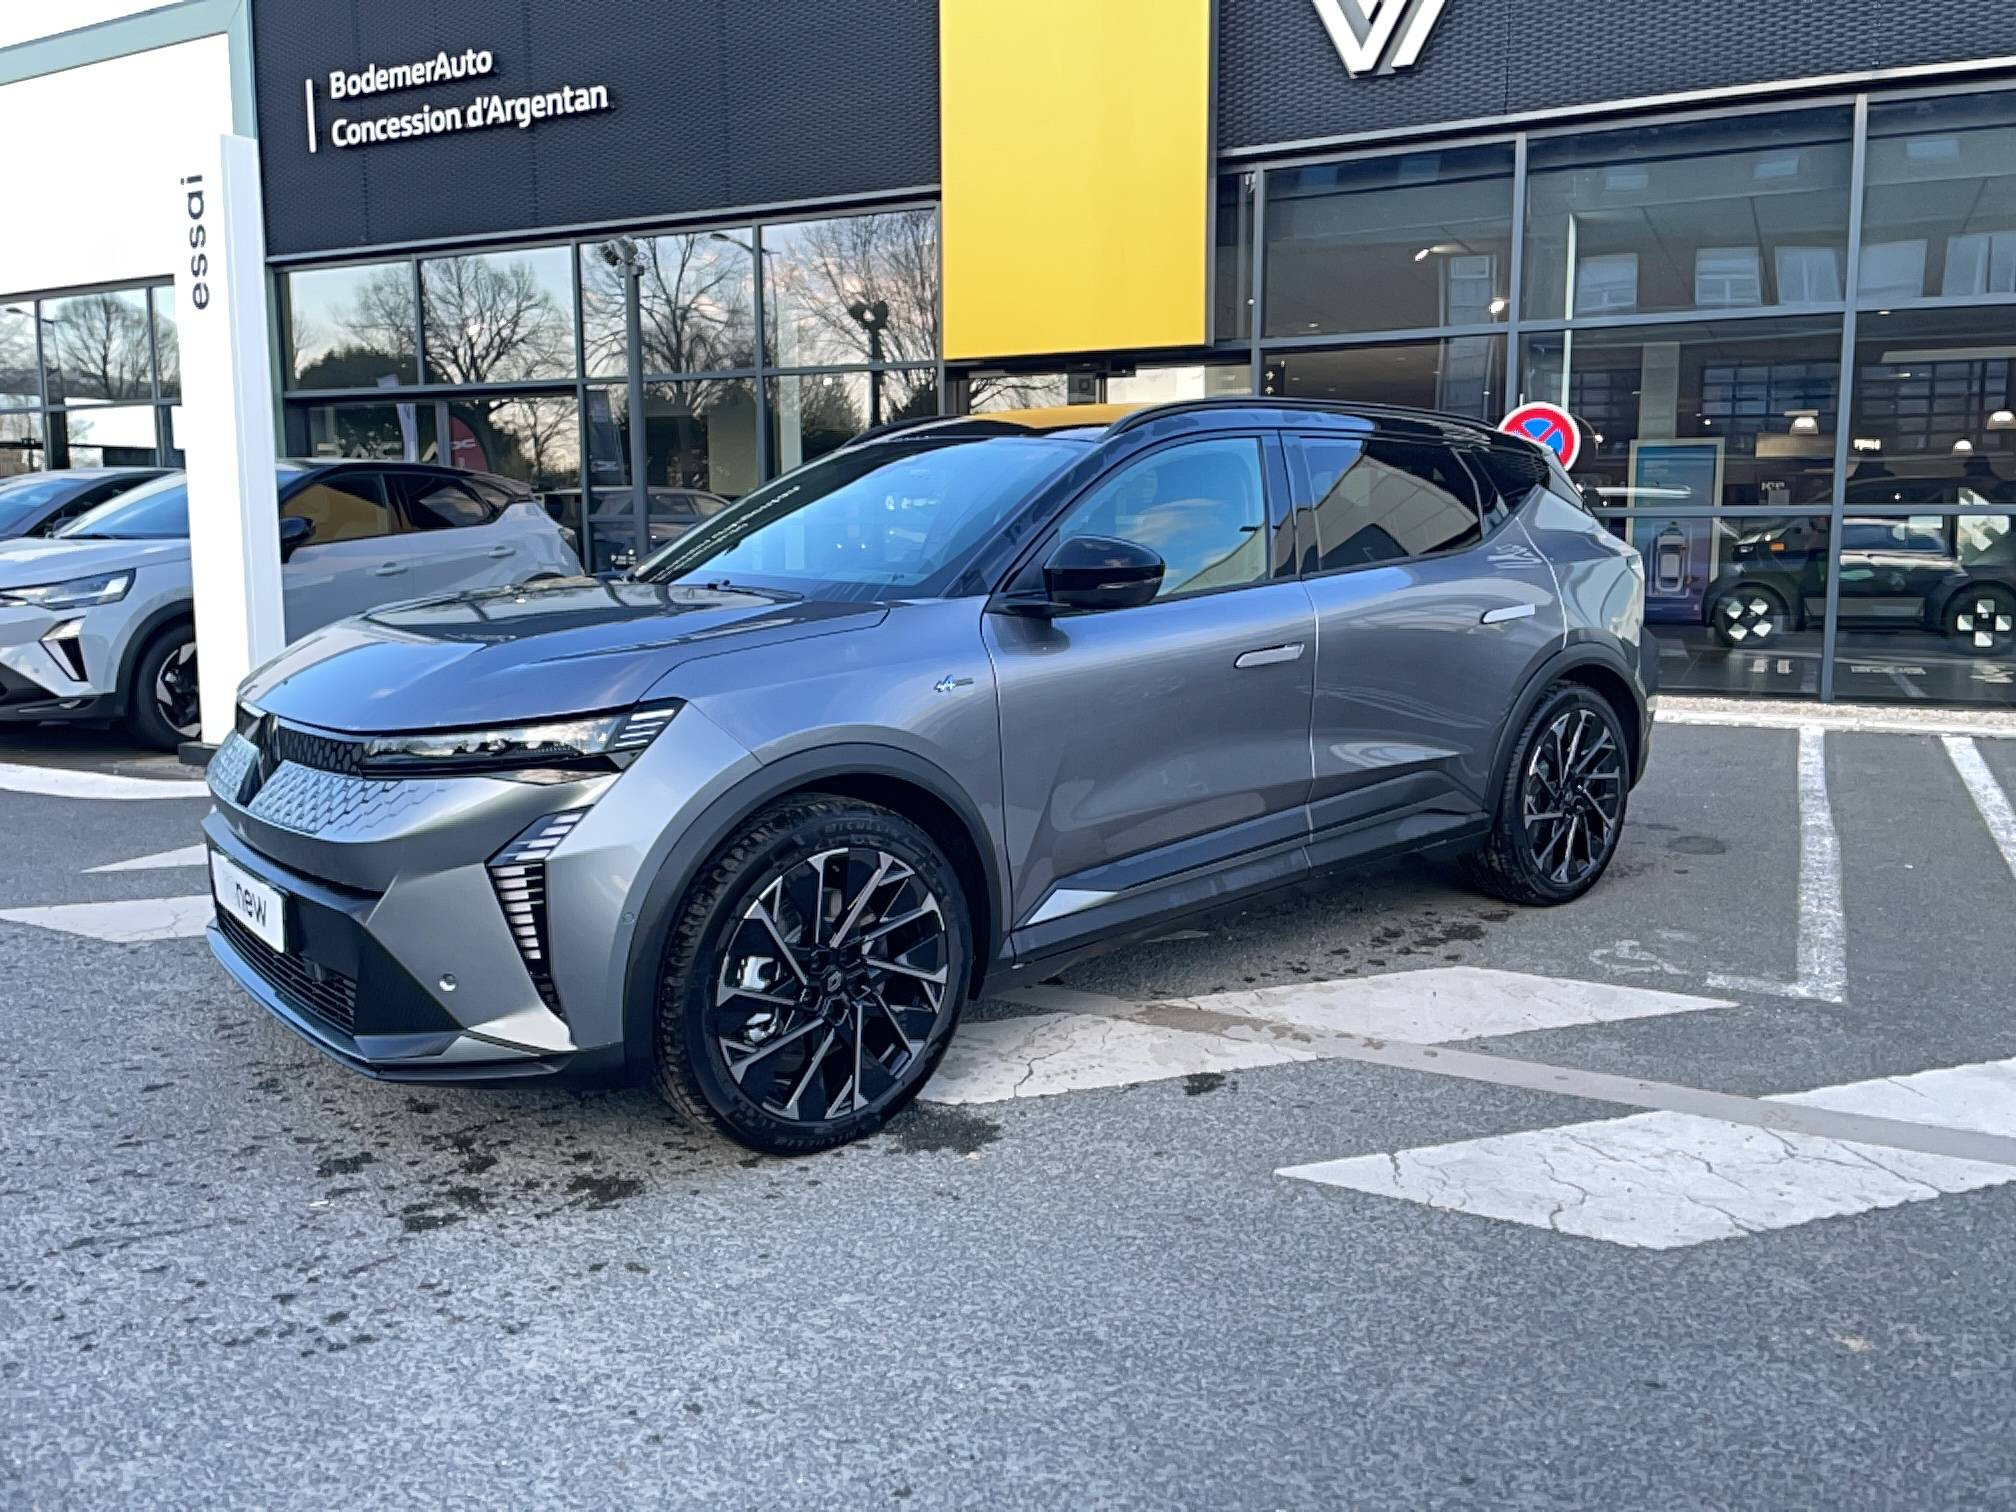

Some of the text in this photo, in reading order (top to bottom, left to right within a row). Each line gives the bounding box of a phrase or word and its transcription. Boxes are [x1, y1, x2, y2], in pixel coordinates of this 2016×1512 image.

[329, 48, 493, 100] BodemerAuto
[331, 84, 609, 148] Concession d'Argentan
[180, 174, 210, 310] essai
[235, 882, 267, 929] new
